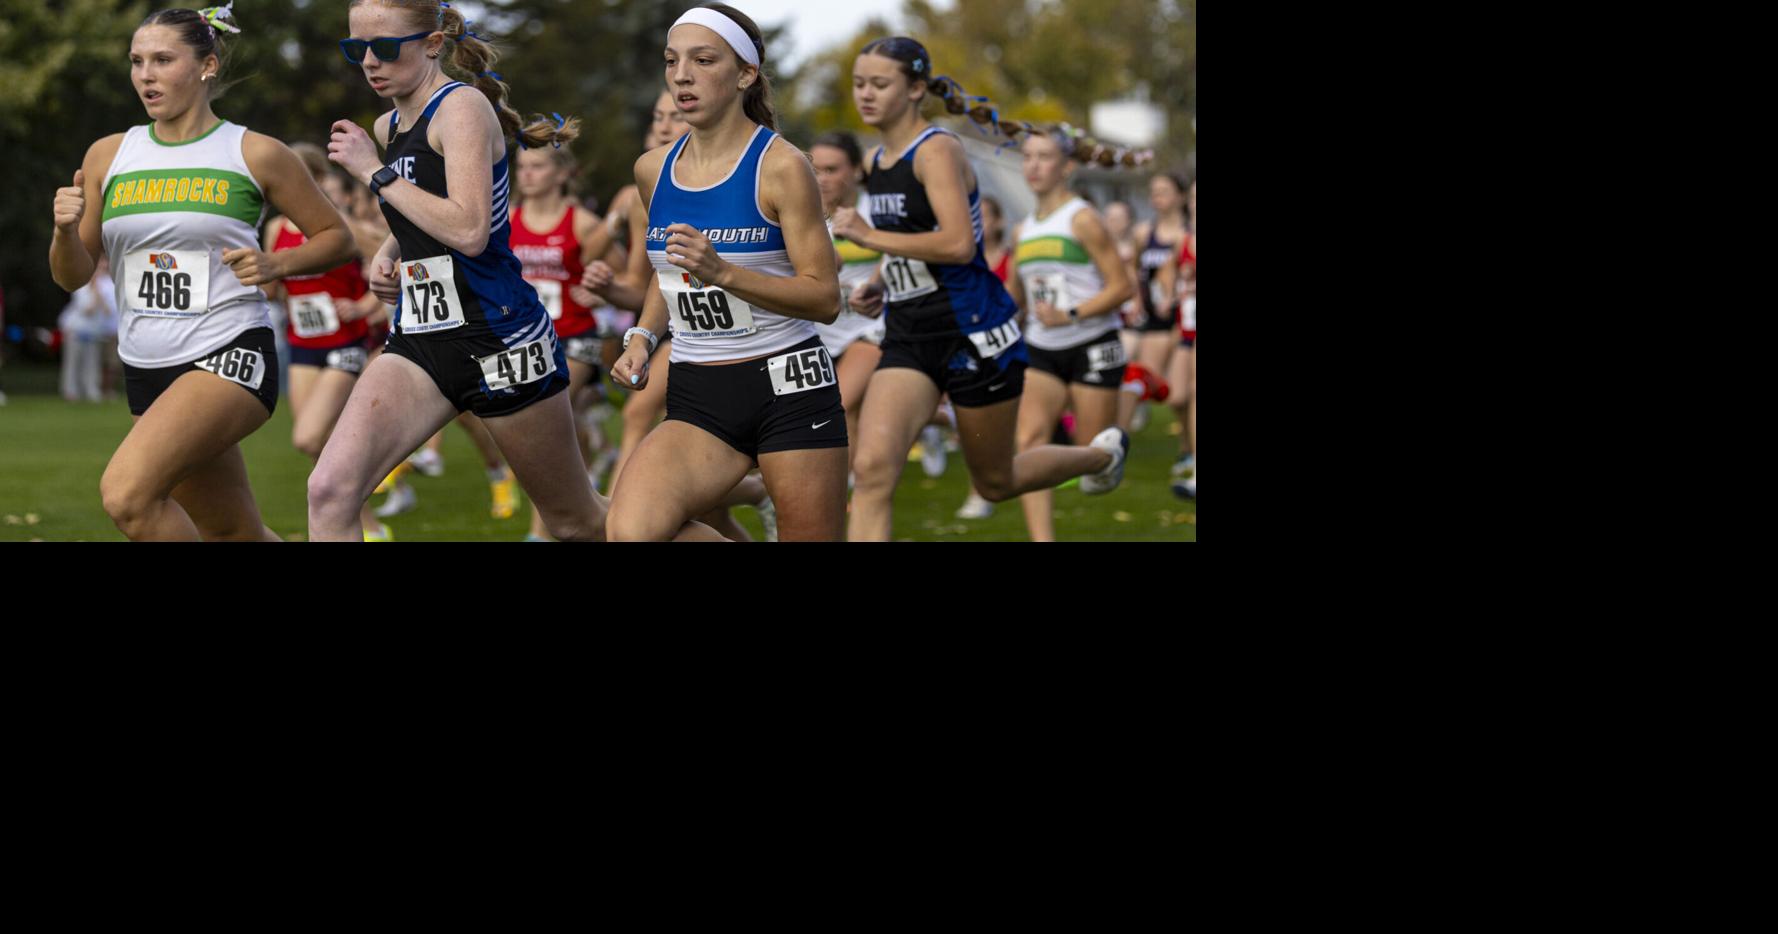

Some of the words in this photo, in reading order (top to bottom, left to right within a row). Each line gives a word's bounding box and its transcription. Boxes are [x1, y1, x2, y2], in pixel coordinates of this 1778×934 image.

[112, 177, 230, 208] SHAMROCKS
[138, 271, 191, 310] 466
[407, 281, 449, 323] 473
[678, 290, 734, 330] 459
[206, 349, 257, 382] 466
[497, 342, 547, 384] 473
[785, 348, 833, 389] 459
